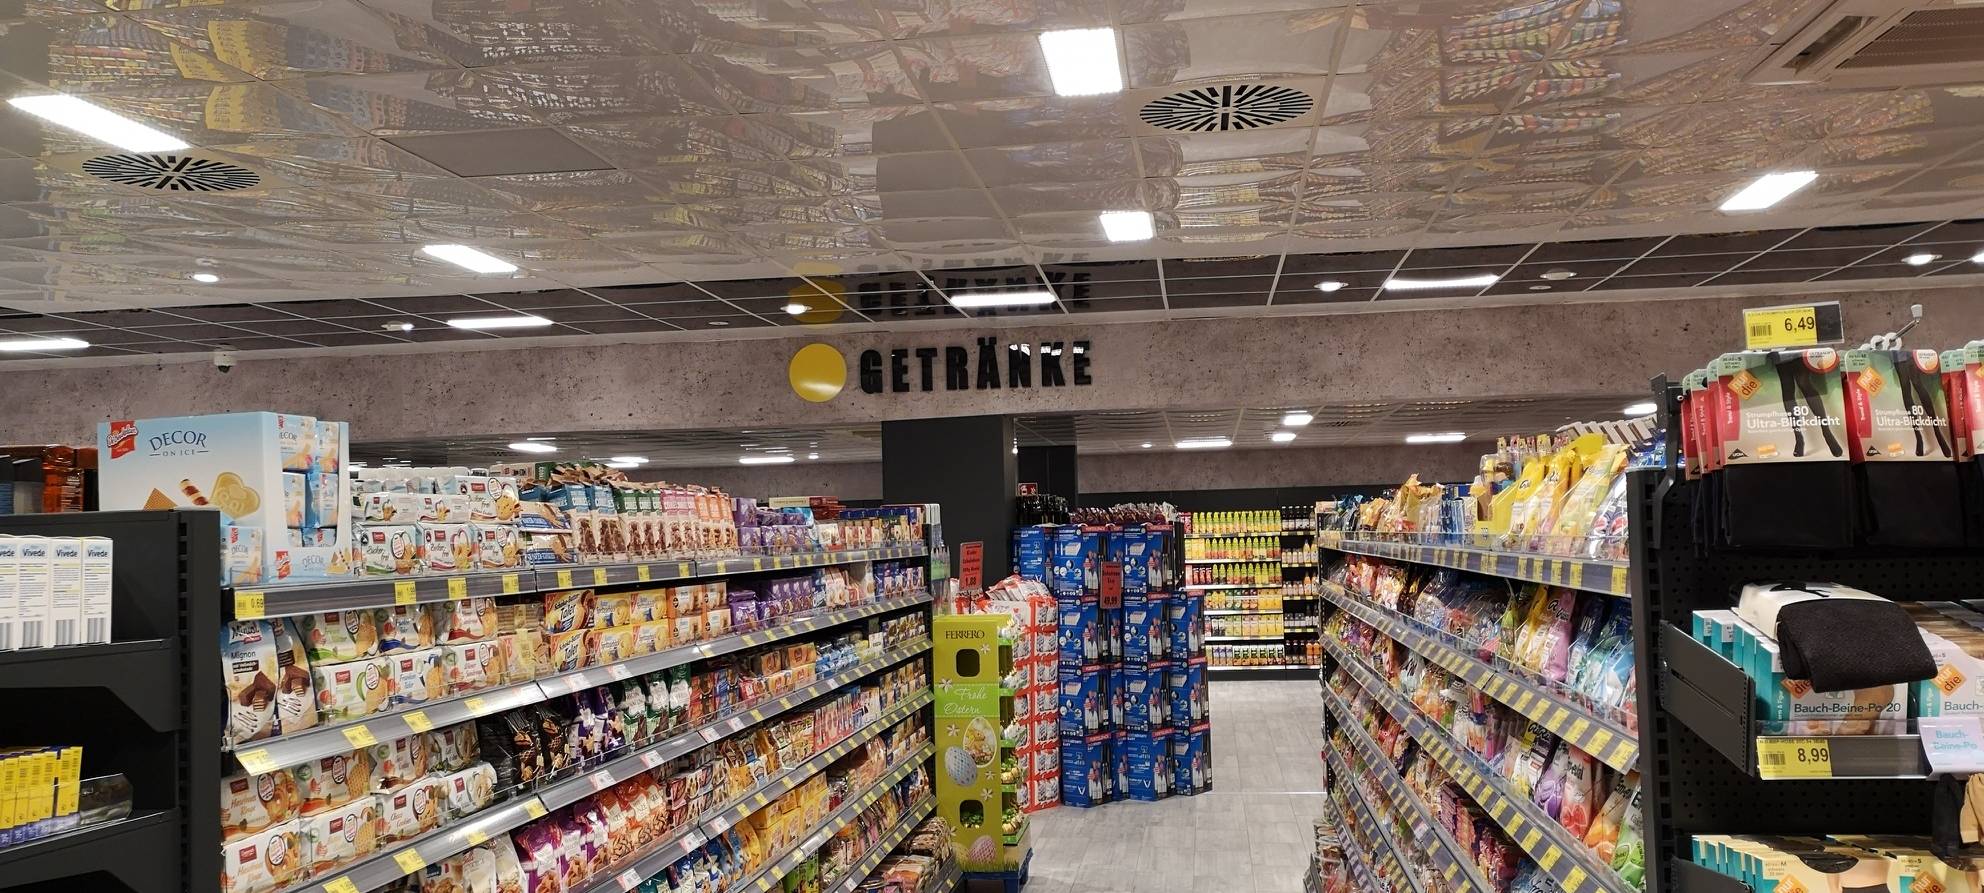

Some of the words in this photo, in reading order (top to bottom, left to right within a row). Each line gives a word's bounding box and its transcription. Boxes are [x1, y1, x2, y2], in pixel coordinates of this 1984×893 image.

[1784, 316, 1815, 334] 6,49
[860, 337, 1092, 395] GETRÄNKE
[1733, 374, 1749, 390] nur
[1861, 369, 1873, 384] nur
[1742, 380, 1758, 396] die
[1870, 378, 1881, 393] die
[1793, 405, 1809, 416] 80
[1912, 405, 1924, 416] 80
[1747, 415, 1841, 430] Ultra-Blickdicht
[1877, 416, 1947, 427] Ultra-Blickdicht
[149, 430, 207, 451] DECOR
[0, 549, 15, 557] vede
[23, 549, 45, 557] Vivede
[56, 549, 78, 557] Vivede
[88, 549, 108, 557] Vivede
[945, 629, 985, 640] FERRERO
[231, 651, 256, 661] Mignon
[1935, 667, 1953, 683] nur
[1944, 675, 1961, 692] die
[1794, 703, 1883, 714] Bauch-Beine-Po
[1886, 703, 1901, 713] 20
[1944, 700, 1984, 711] Bauch-
[1797, 747, 1829, 765] 8,99
[1912, 875, 1931, 893] nur
